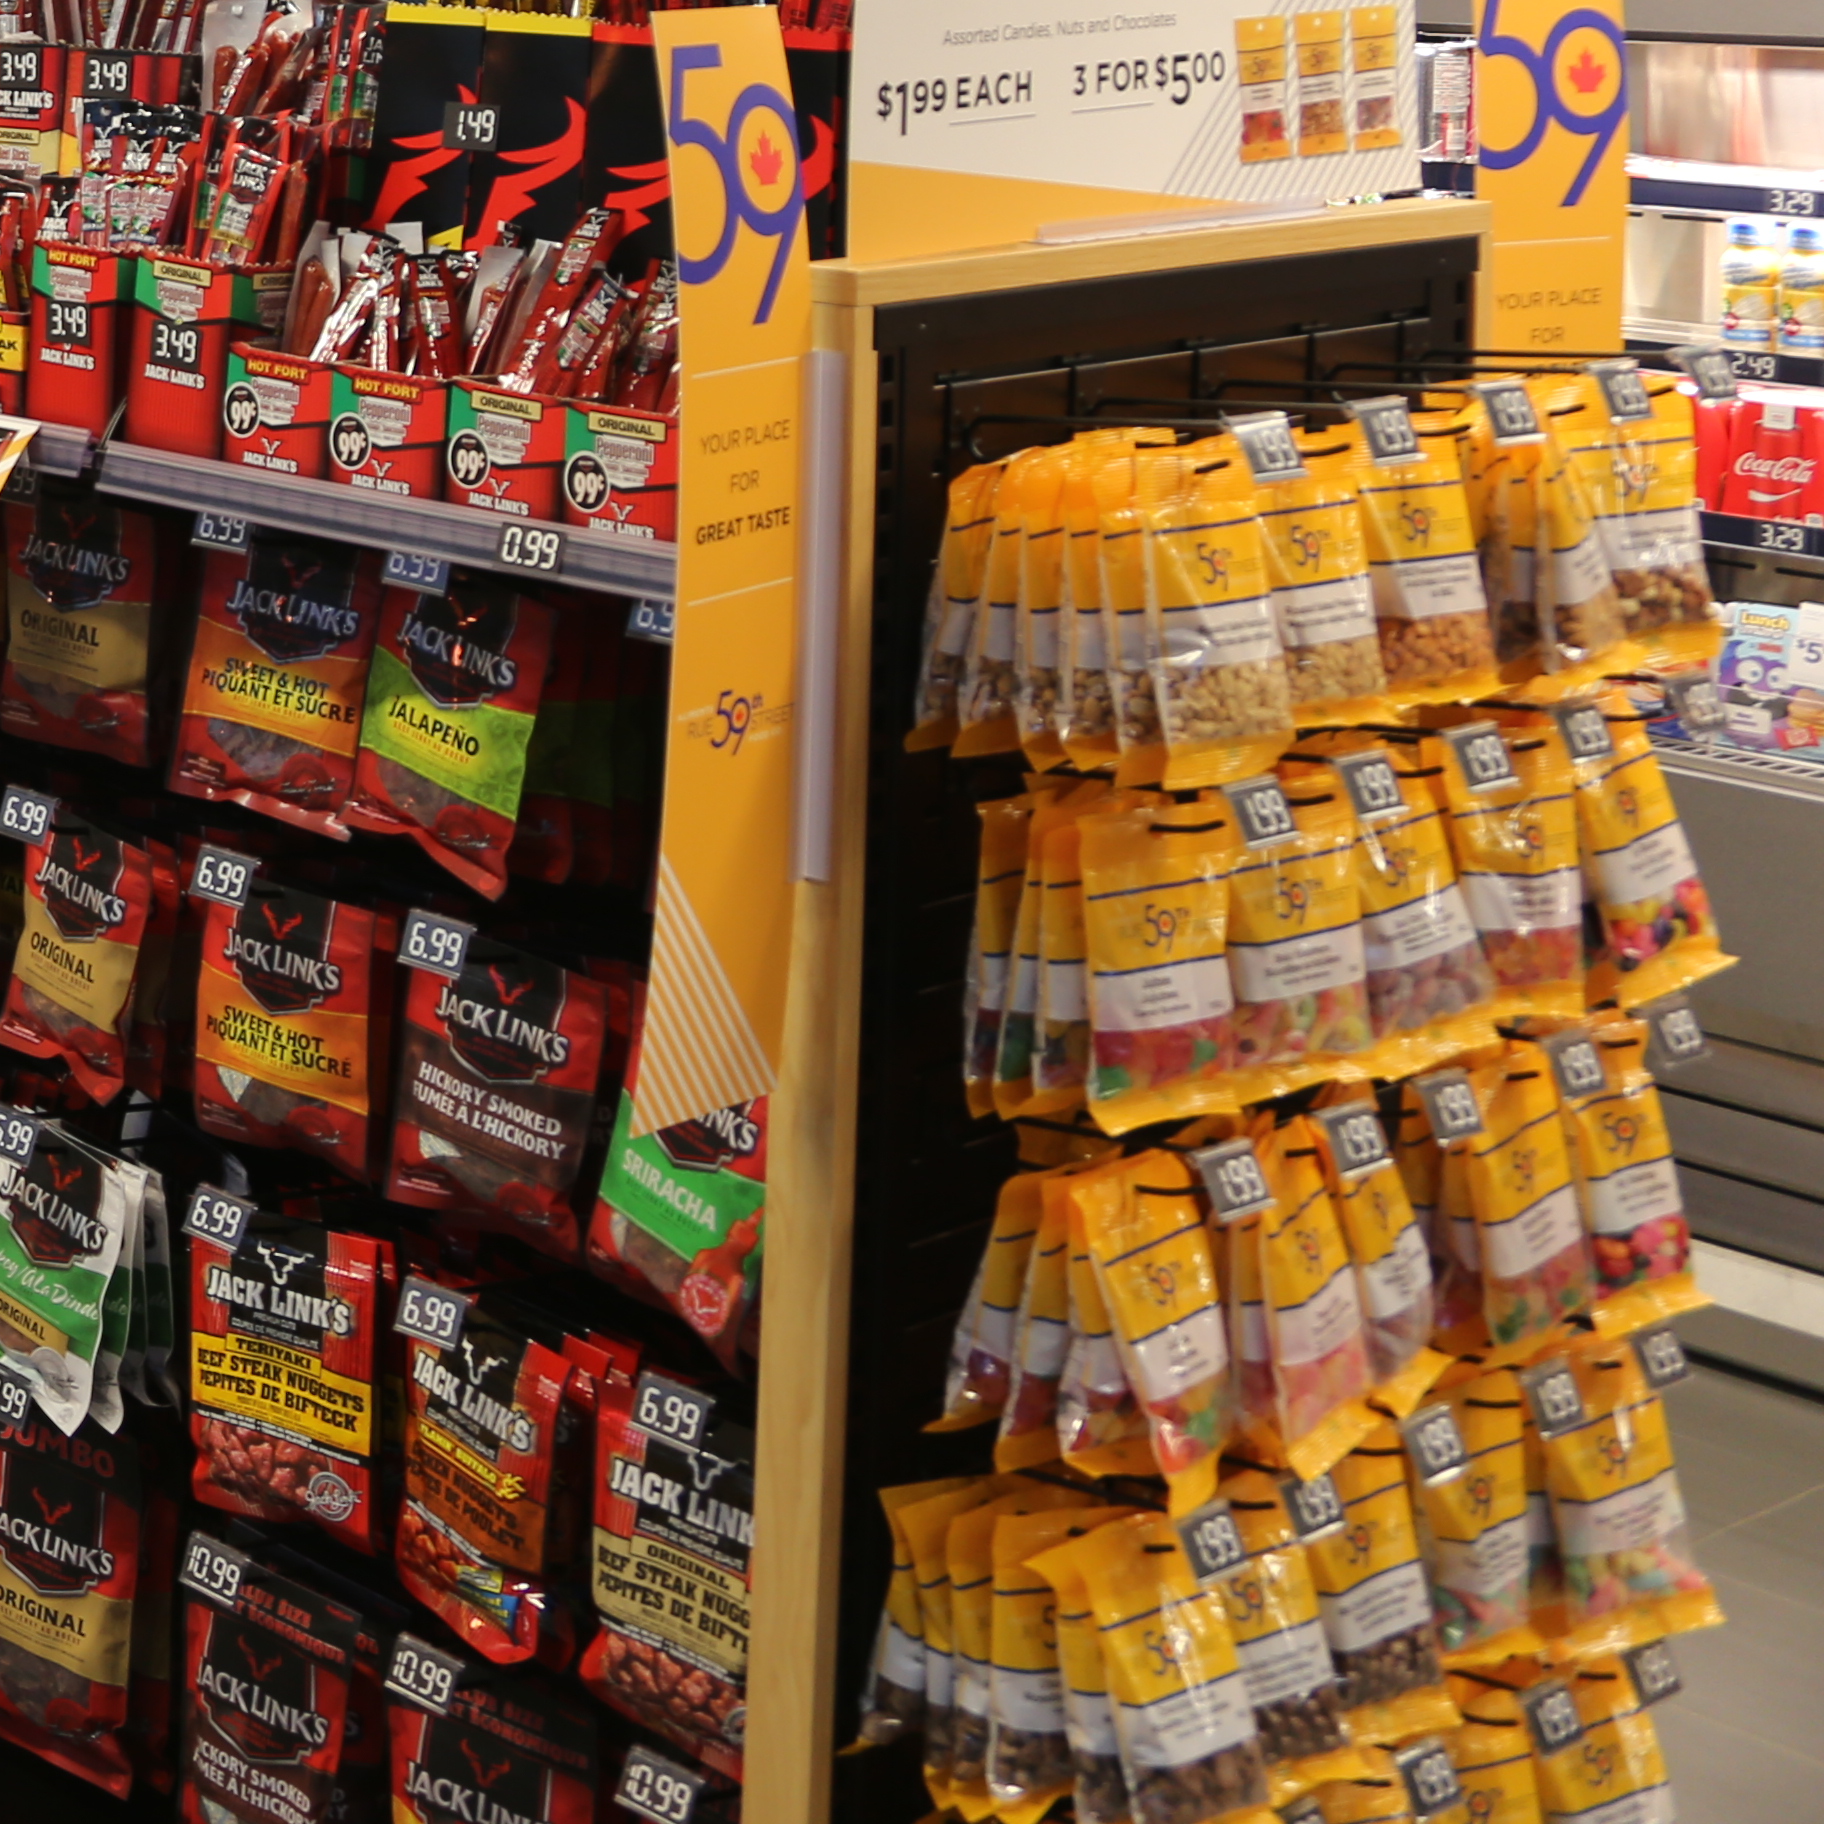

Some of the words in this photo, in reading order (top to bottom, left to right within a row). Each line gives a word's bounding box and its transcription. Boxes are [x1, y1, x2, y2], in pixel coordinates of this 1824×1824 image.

[942, 24, 999, 46] Assorted
[1056, 19, 1084, 36] Nuts
[1087, 16, 1110, 34] and
[1114, 12, 1177, 31] Chocolates
[955, 70, 1033, 109] EACH
[1073, 65, 1087, 96] 3
[1096, 59, 1149, 93] FOR
[670, 44, 807, 326] 59
[1770, 189, 1815, 215] 3.29
[700, 424, 743, 455] YOUR
[745, 419, 791, 447] PLACE
[730, 469, 760, 494] FOR
[502, 526, 559, 570] 0.99
[695, 514, 746, 547] GREAT
[748, 506, 791, 533] TASTE
[388, 695, 481, 758] JALAPEÑO
[30, 931, 95, 984] ORIGINAL
[407, 921, 464, 968] 6.99
[206, 1013, 269, 1053] PIQUANT
[270, 1042, 289, 1060] ET
[290, 1046, 352, 1079] SUCRÉ
[223, 1004, 271, 1039] SWEET
[272, 1024, 283, 1042] &
[286, 1028, 325, 1054] HOT
[435, 986, 493, 1038] JACK
[493, 1009, 569, 1063] LINK'S
[412, 1080, 455, 1116] FUMÉE
[455, 1098, 470, 1129] À
[471, 1111, 566, 1160] L'HICKORY
[418, 1061, 485, 1105] HICKORY
[487, 1090, 562, 1137] SMOKED
[205, 1267, 266, 1310] JACK
[268, 1283, 352, 1335] LINK'S
[236, 1337, 312, 1371] TERIYAKI
